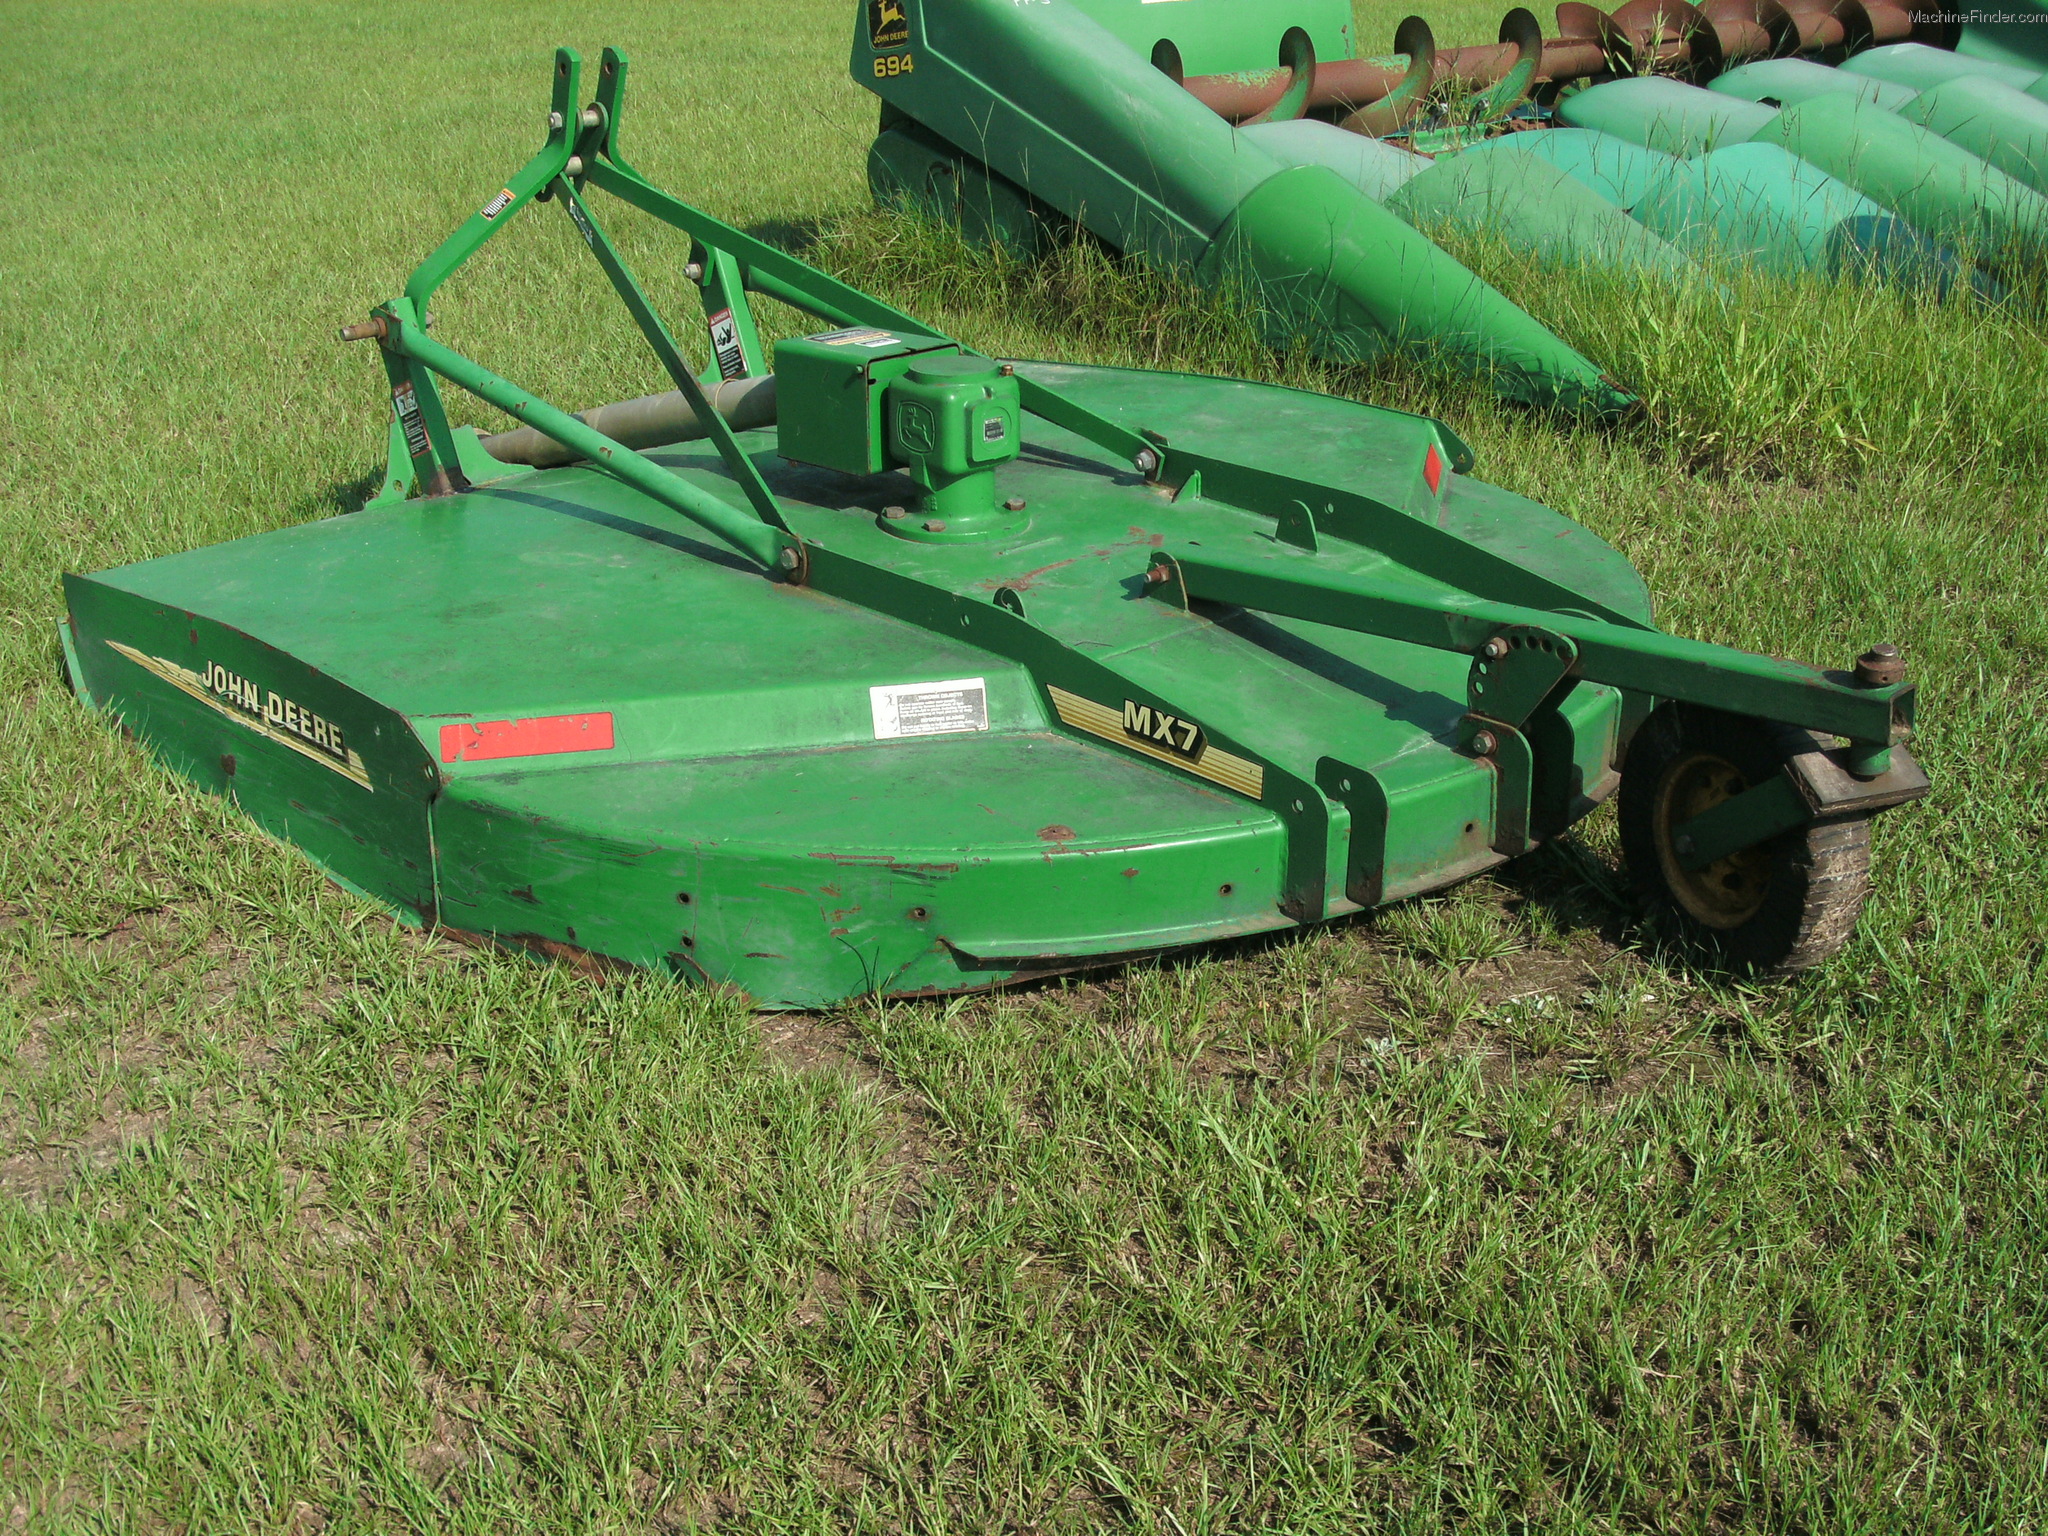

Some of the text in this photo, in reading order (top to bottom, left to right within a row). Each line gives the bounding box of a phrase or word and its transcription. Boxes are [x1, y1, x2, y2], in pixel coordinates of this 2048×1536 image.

[873, 30, 909, 44] JOHN DEERE
[874, 54, 914, 78] 694
[201, 660, 344, 755] JOHN DEERE
[1123, 699, 1200, 753] MX7
